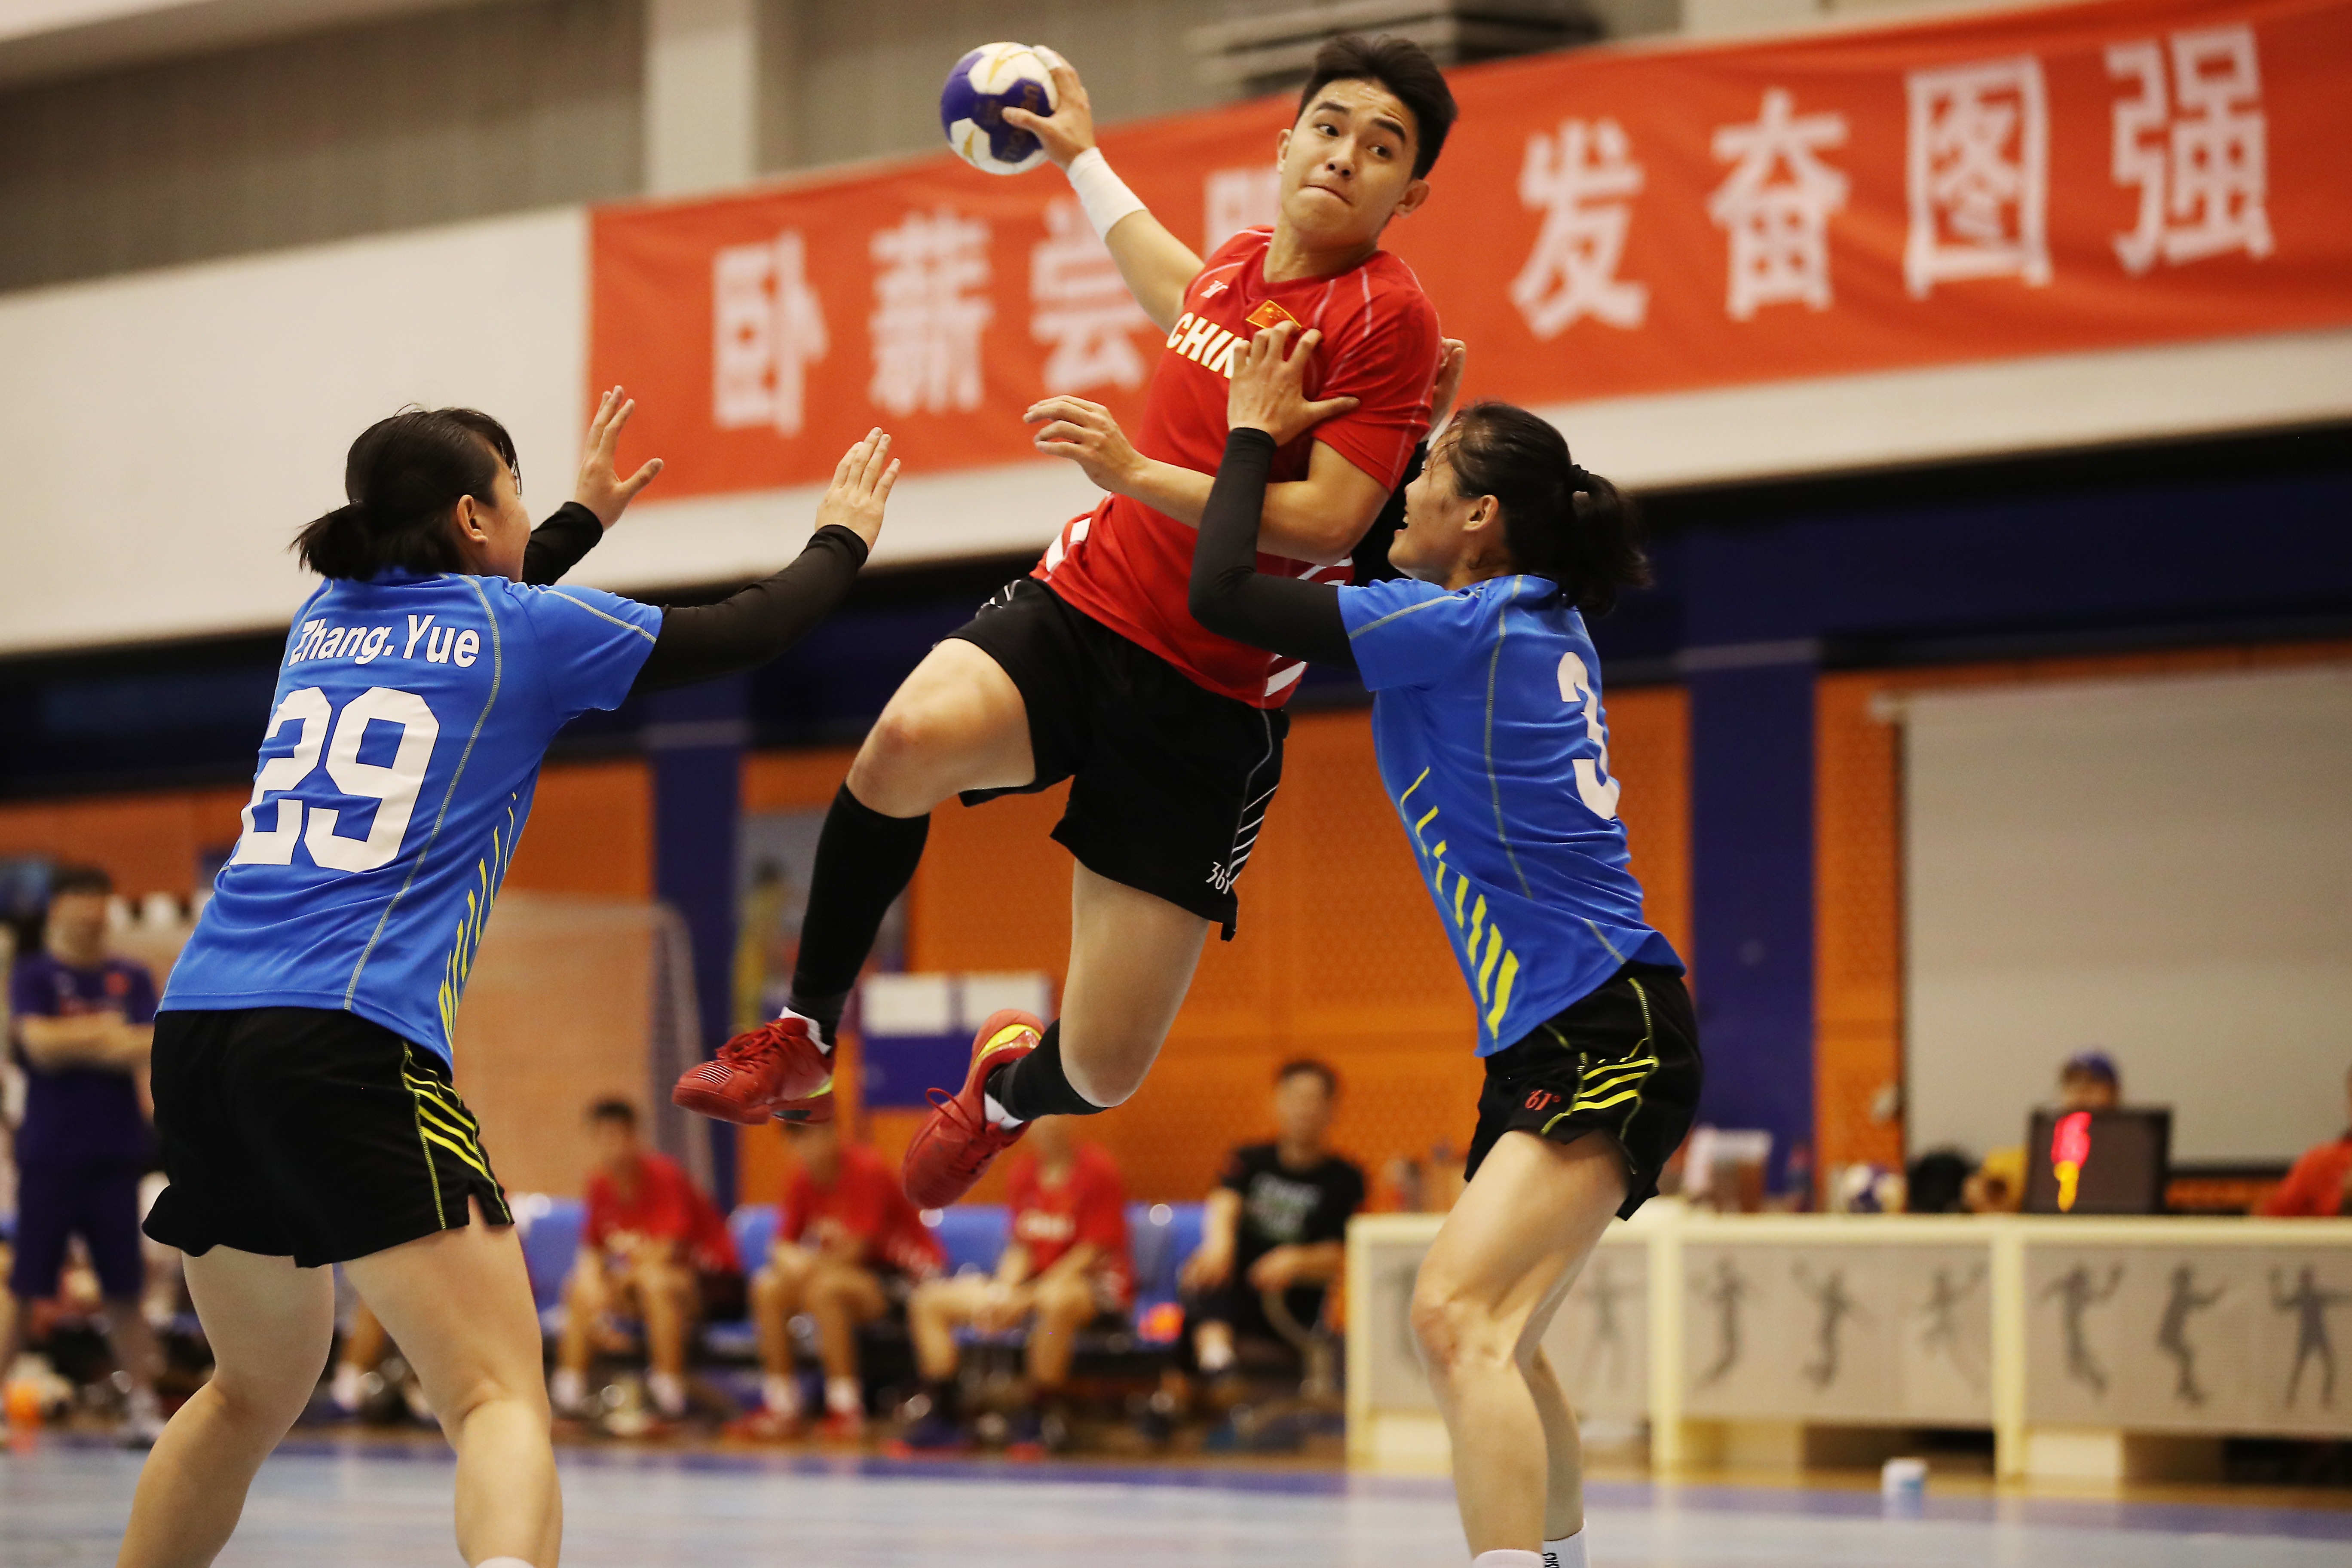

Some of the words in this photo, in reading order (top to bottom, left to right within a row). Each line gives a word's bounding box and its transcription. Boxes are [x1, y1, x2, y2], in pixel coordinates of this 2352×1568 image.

[1509, 22, 2274, 340] 发奋图强
[1166, 312, 1243, 379] CHIN
[229, 686, 440, 873] 29
